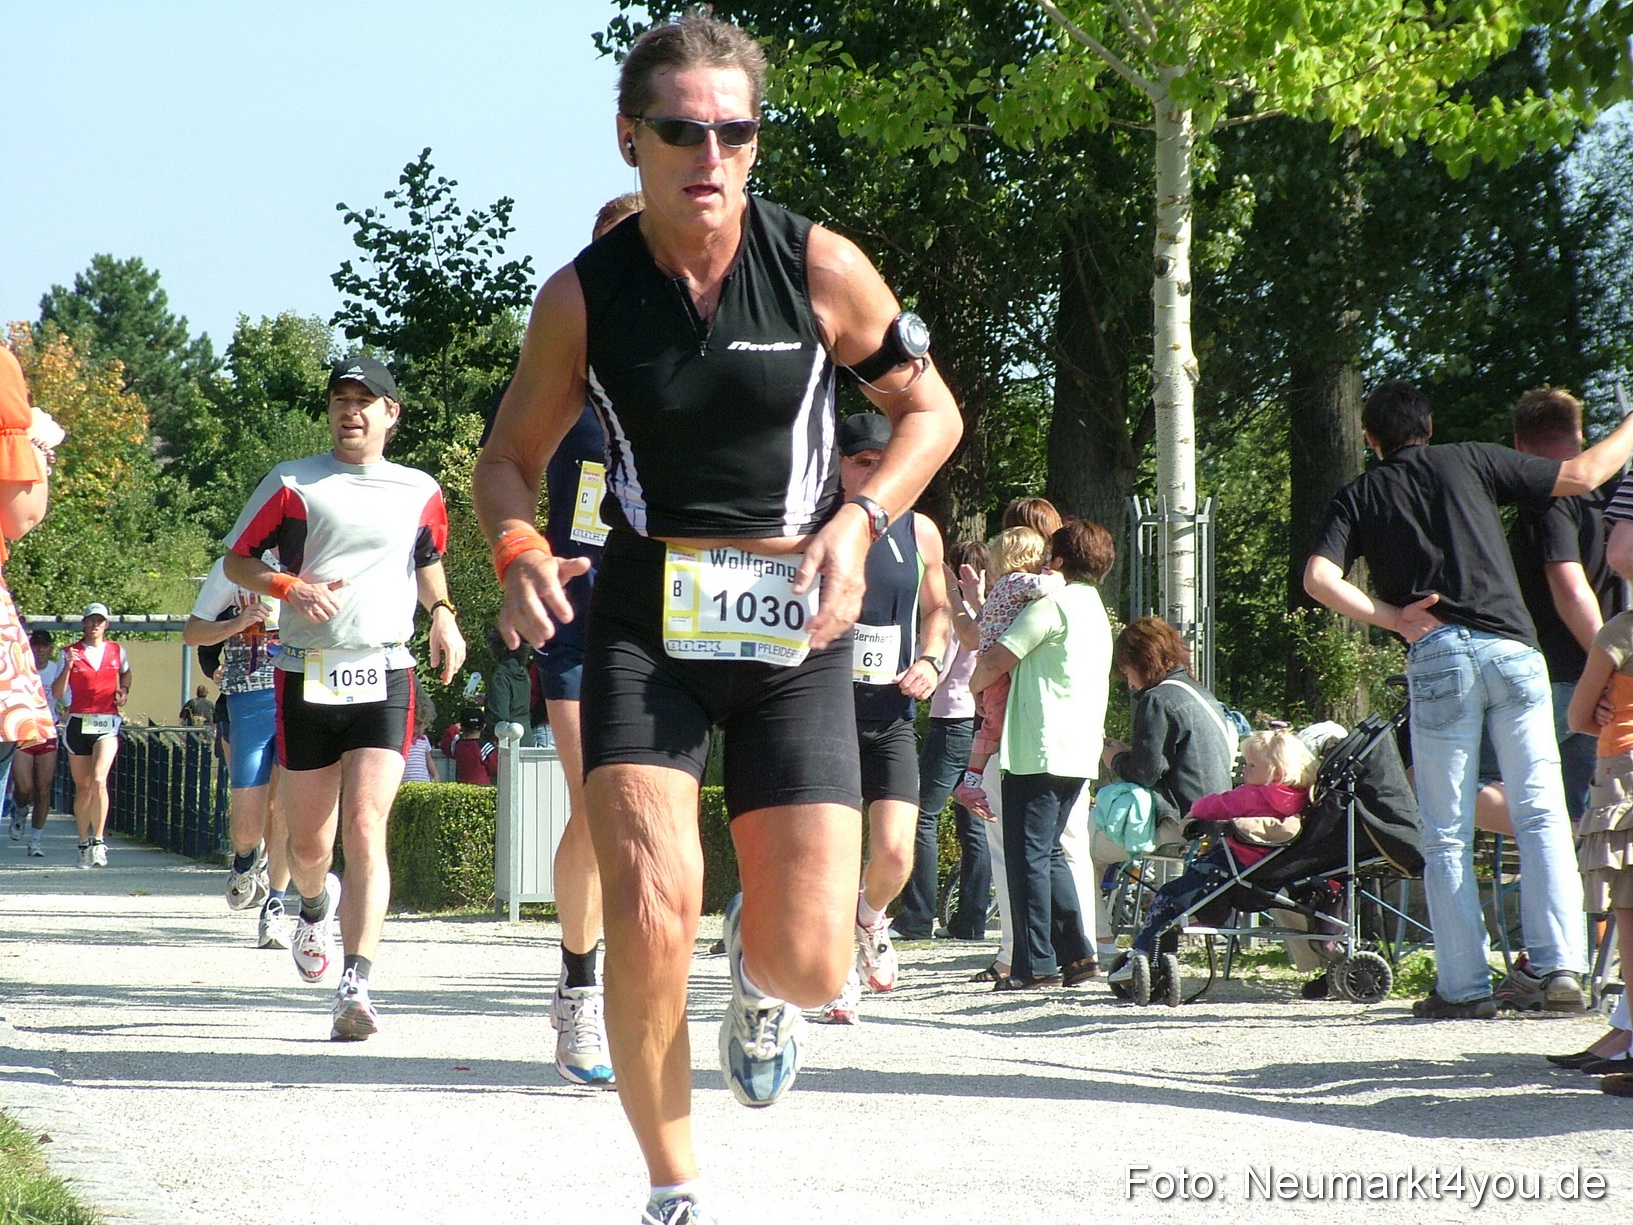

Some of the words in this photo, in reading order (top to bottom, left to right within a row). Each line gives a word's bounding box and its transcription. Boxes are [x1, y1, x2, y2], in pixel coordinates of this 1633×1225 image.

[710, 548, 797, 583] Wolfgang
[673, 580, 682, 597] B
[713, 590, 805, 630] 1030
[666, 640, 721, 652] BOCK
[863, 652, 883, 667] 63
[329, 669, 378, 686] 1058
